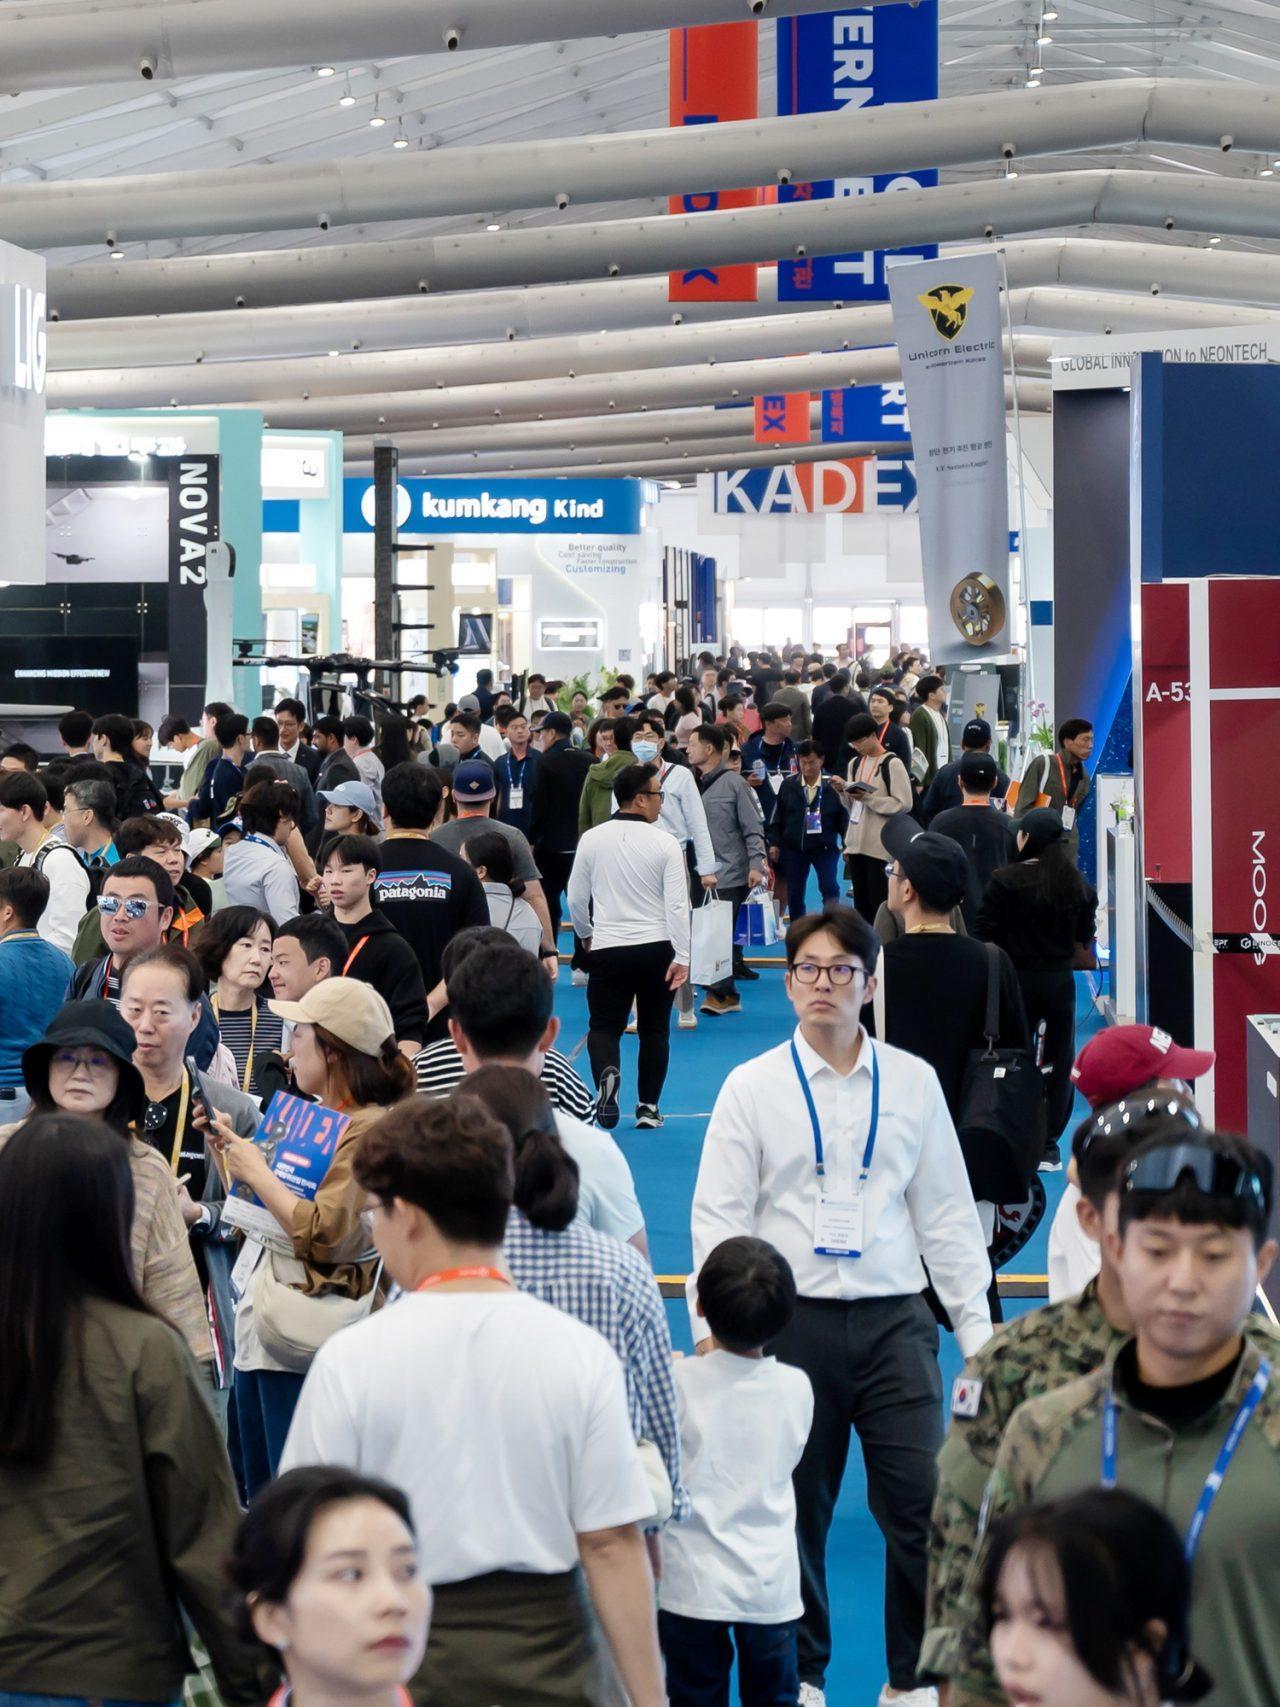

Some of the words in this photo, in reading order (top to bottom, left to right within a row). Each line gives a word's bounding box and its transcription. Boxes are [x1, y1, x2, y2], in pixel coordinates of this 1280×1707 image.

[15, 283, 47, 394] LIG
[908, 348, 951, 361] Unicorn
[954, 341, 996, 355] Electric
[1061, 355, 1108, 372] GLOBAL
[1186, 350, 1196, 362] to
[1200, 342, 1268, 363] NEONTECH
[422, 491, 547, 524] kumkang
[553, 499, 604, 518] Kind
[597, 544, 627, 553] quality
[565, 564, 626, 575] Customizing
[379, 886, 447, 901] patagonia
